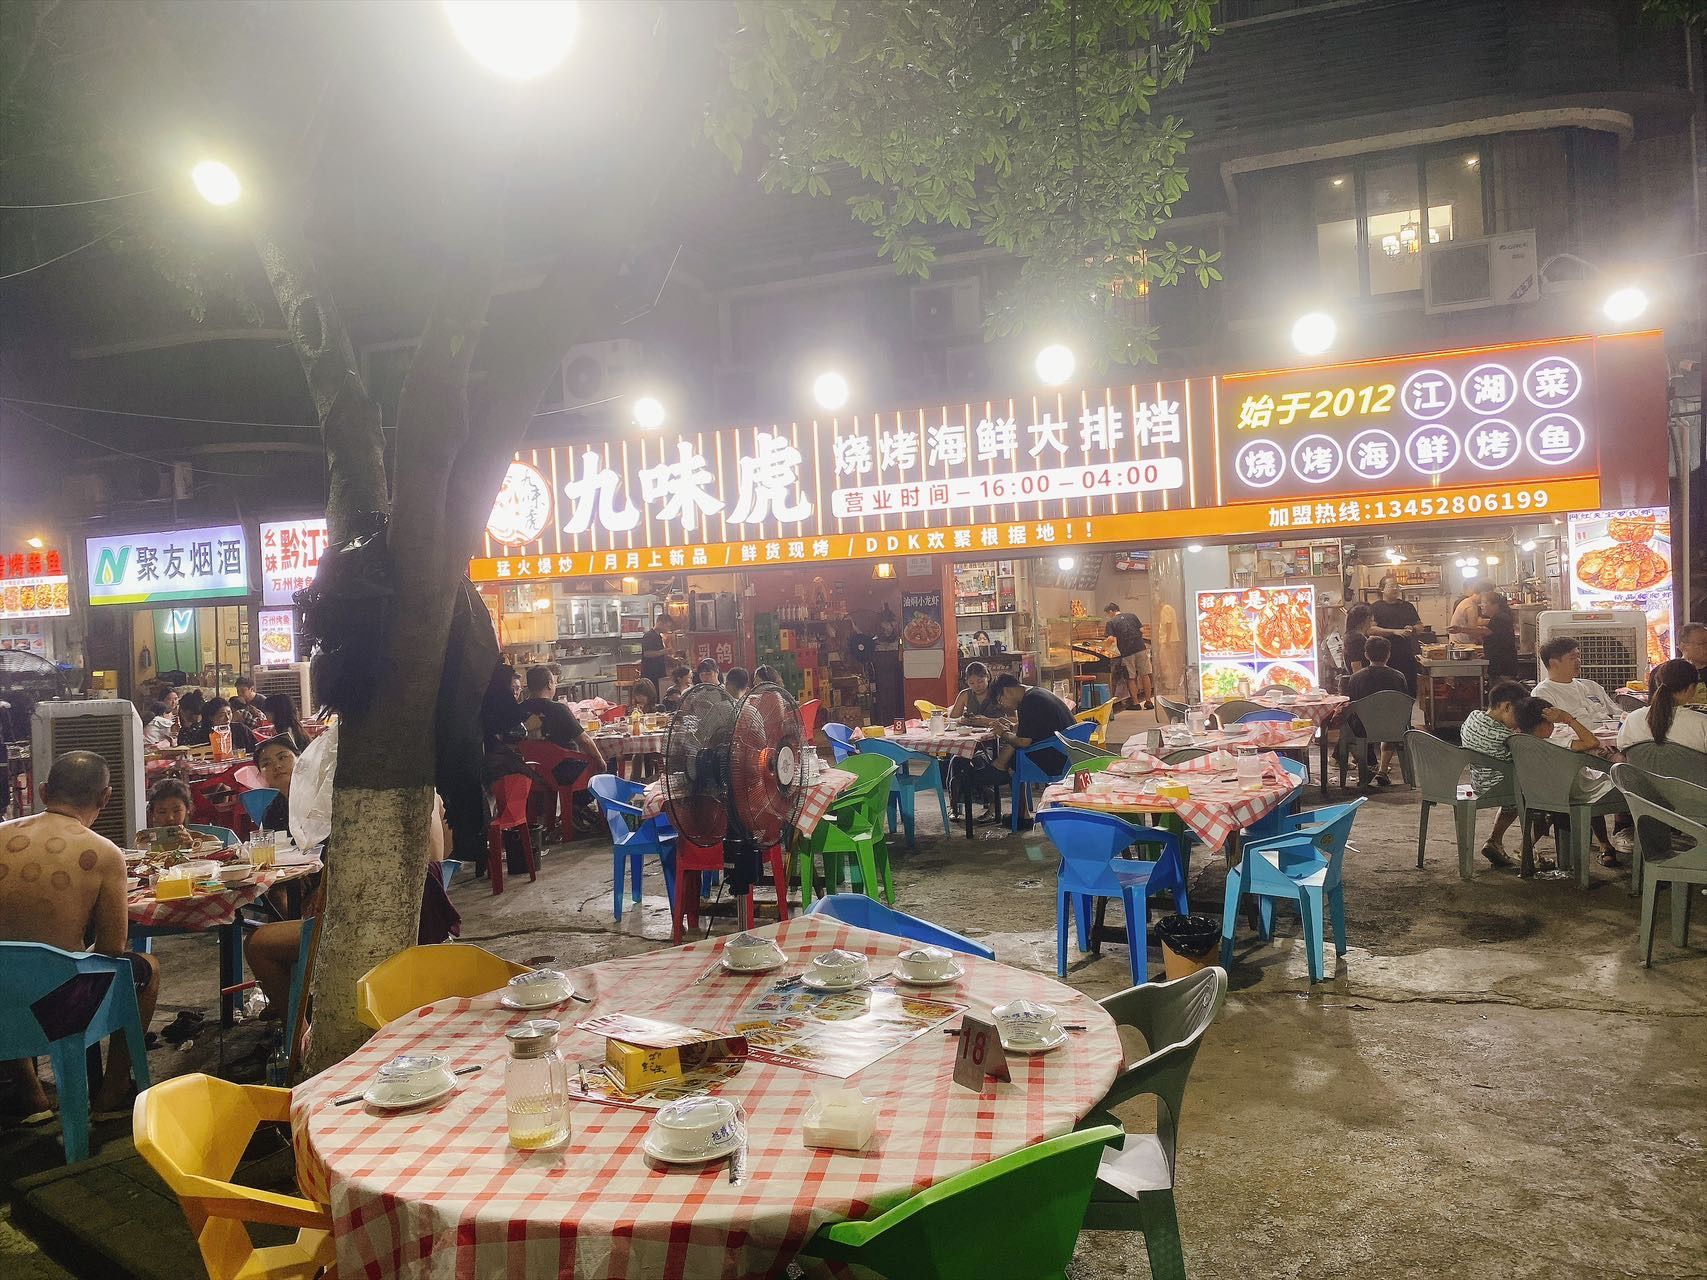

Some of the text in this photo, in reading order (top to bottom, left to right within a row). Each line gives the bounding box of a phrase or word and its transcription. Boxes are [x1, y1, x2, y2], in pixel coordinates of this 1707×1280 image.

[1238, 383, 1396, 430] 始于2012
[1410, 364, 1571, 412] 江湖菜
[833, 400, 1183, 476] 烧烤海鲜大排档
[1243, 422, 1574, 481] 烧烤海鲜烤鱼
[562, 432, 814, 534] 九味虎
[135, 539, 242, 582] 聚友烟酒
[280, 526, 329, 570] 黔江
[496, 555, 573, 578] 猛火爆炒
[896, 720, 903, 731] 8
[1080, 772, 1092, 788] 13
[962, 1026, 987, 1066] 18
